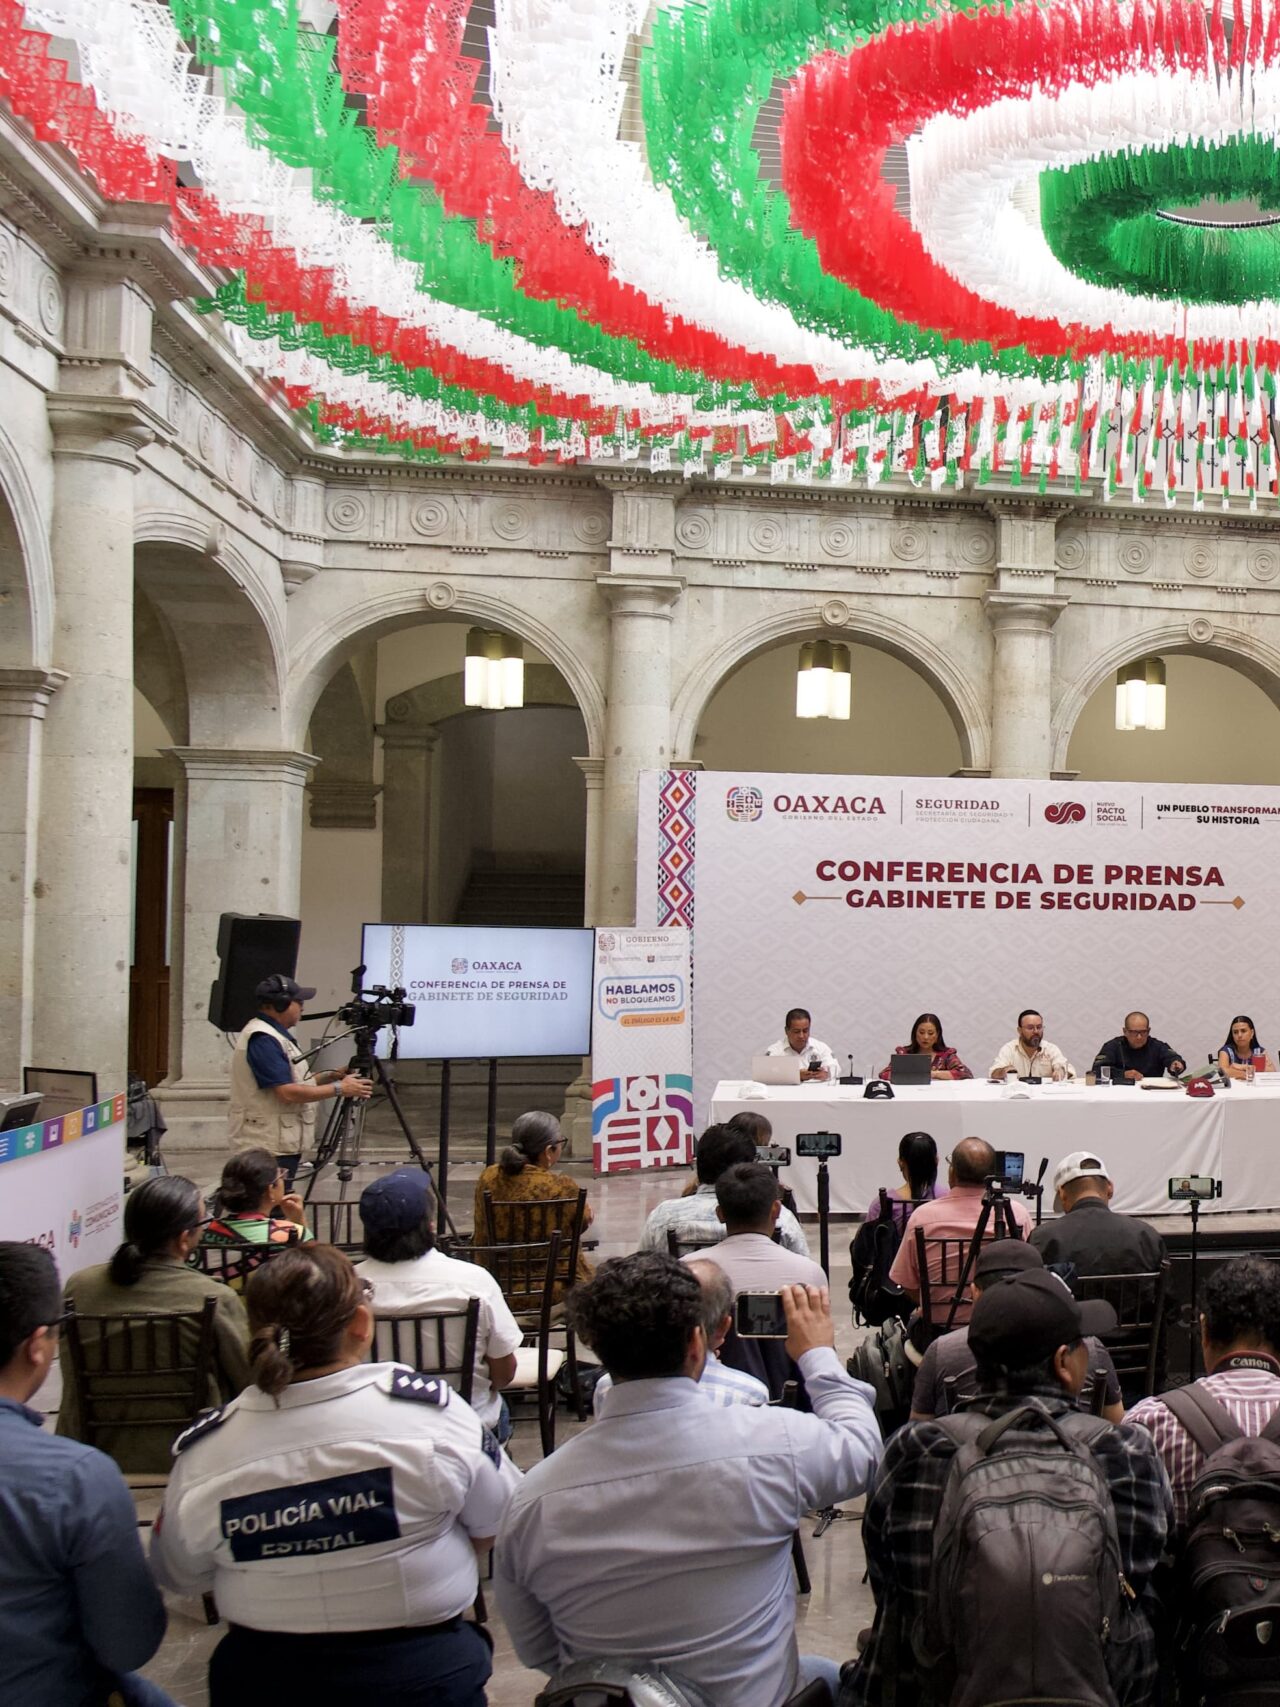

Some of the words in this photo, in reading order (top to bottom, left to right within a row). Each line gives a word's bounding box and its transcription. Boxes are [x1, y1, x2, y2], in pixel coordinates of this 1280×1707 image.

[773, 795, 886, 815] OAXACA
[915, 799, 1000, 810] SEGURIDAD
[1156, 804, 1171, 812] UN
[1172, 804, 1210, 813] PUEBLO
[1096, 814, 1127, 822] SOCIAL
[1196, 815, 1210, 824] SU
[1212, 816, 1260, 825] HISTORIA
[816, 860, 1043, 884] CONFERENCIA
[1054, 864, 1094, 885] DE
[1104, 864, 1225, 887] PRENSA
[845, 889, 986, 909] GABINETE
[995, 891, 1031, 910] DE
[1040, 892, 1197, 912] SEGURIDAD
[472, 960, 522, 972] OAXACA
[410, 980, 488, 990] CONFERENCIA
[490, 980, 506, 990] DE
[509, 980, 550, 990] PRENSA
[553, 980, 567, 990] DE
[606, 984, 676, 995] HABLAMOS
[408, 990, 475, 1002] GABINETE
[477, 990, 494, 1002] DE
[496, 990, 568, 1002] SEGURIDAD
[620, 995, 676, 1004] BLOQUEAMOS
[1230, 1357, 1271, 1370] Canon
[225, 1500, 324, 1538] POLICÍA
[328, 1489, 385, 1517] VIAL
[261, 1531, 365, 1556] ESTATAL
